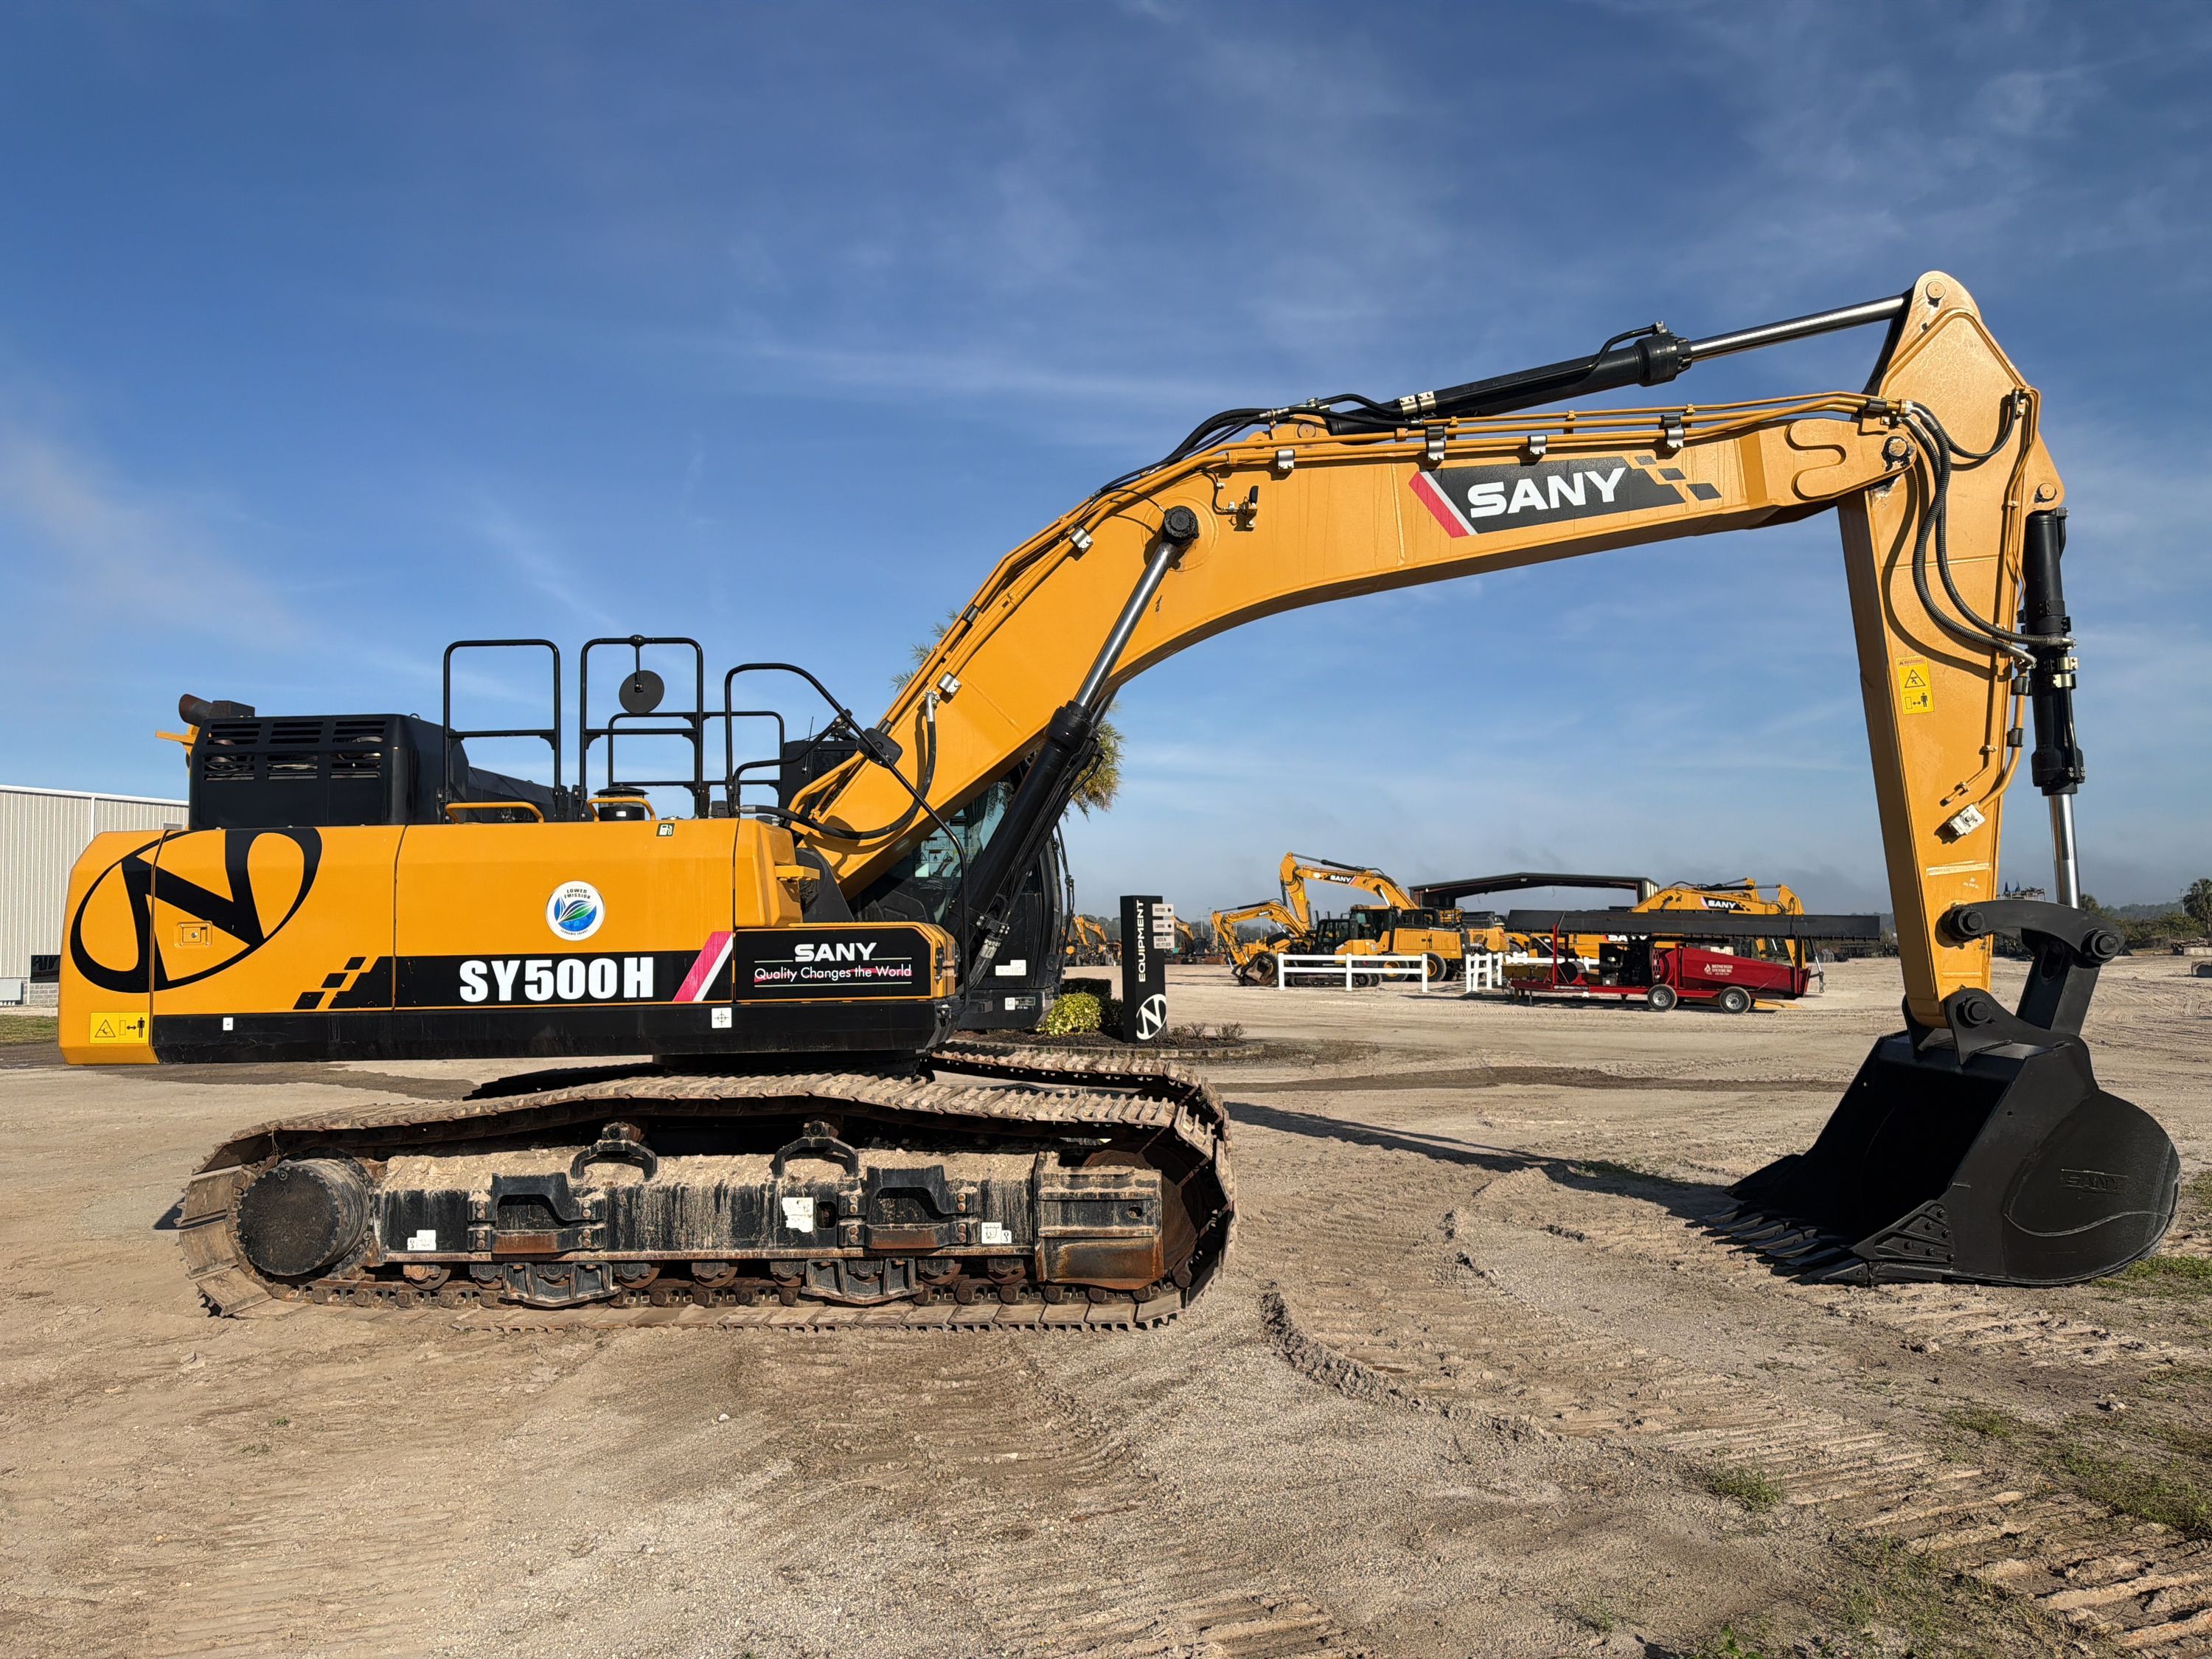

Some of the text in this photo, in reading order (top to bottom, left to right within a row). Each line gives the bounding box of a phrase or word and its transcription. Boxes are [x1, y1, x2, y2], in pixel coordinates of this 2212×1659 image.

[1467, 467, 1627, 518] SANY
[1708, 900, 1736, 909] SANY
[794, 942, 877, 962] SANY
[1136, 900, 1146, 982] EQUIPMENT
[459, 956, 654, 1003] SY500H
[754, 964, 911, 982] Quality Changes the World
